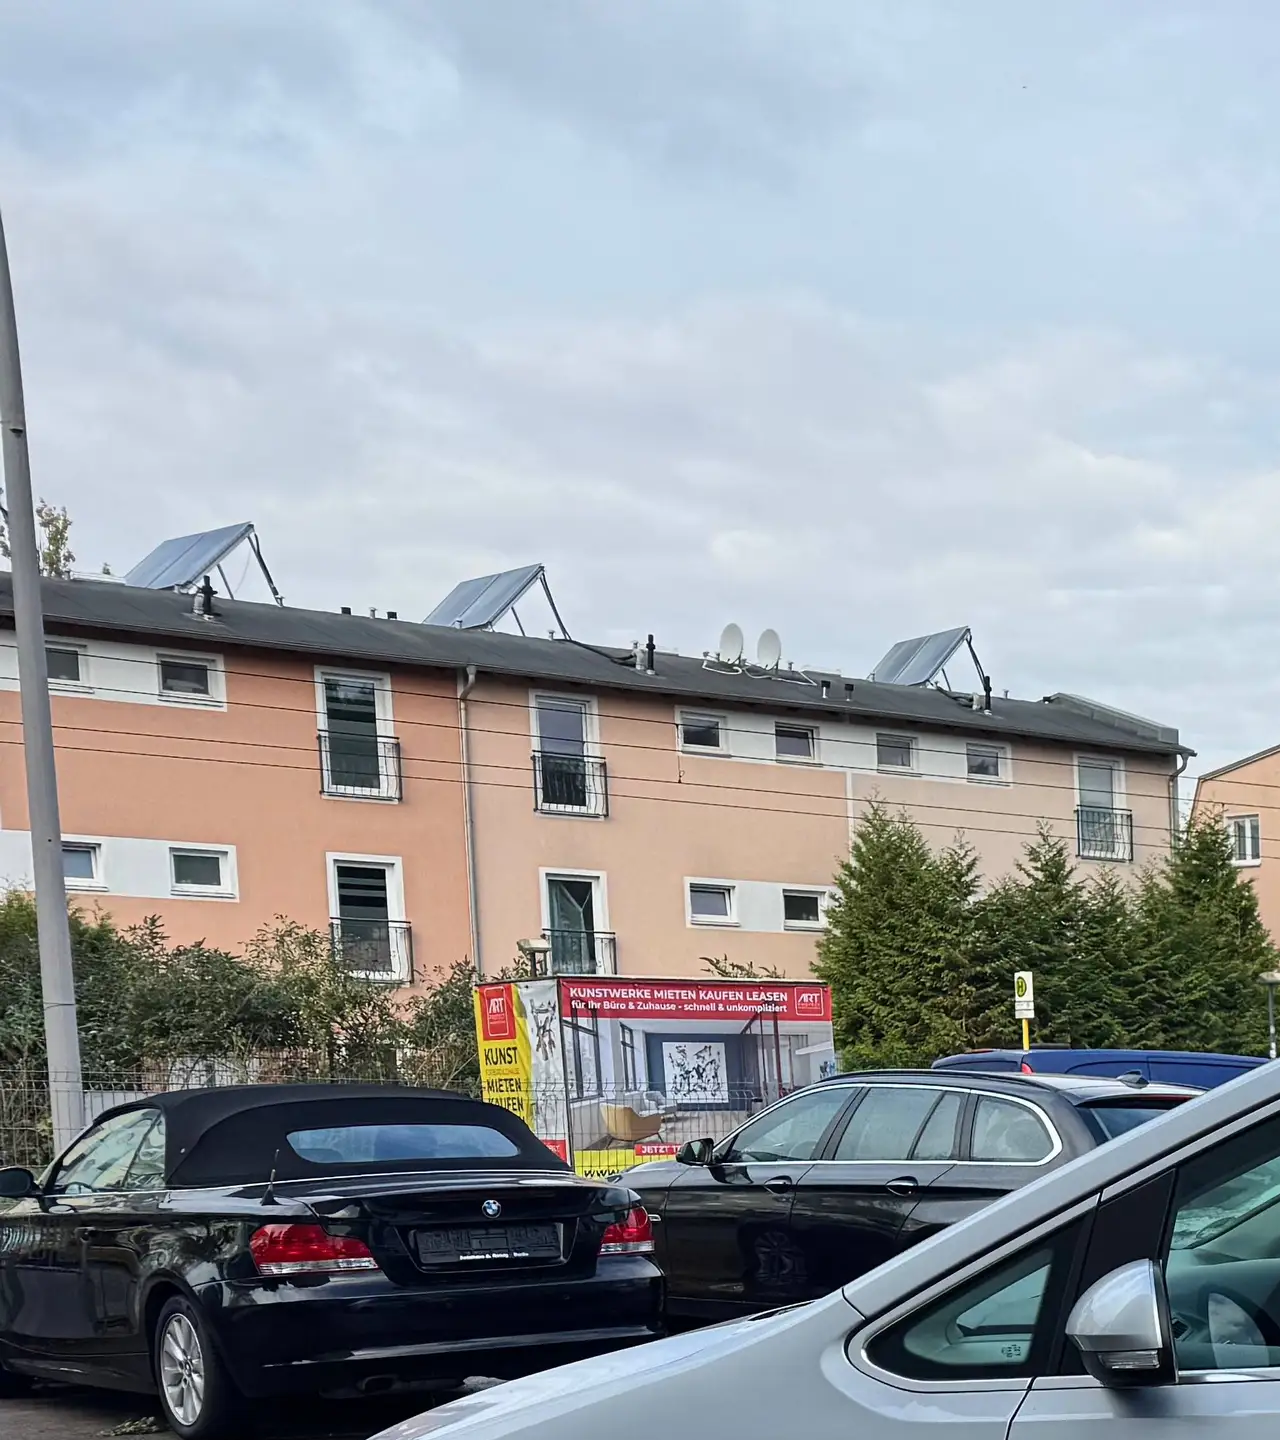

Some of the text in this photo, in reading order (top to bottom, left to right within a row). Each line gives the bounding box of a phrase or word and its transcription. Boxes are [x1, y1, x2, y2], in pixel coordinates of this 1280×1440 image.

[569, 987, 788, 1002] KUNSTWERKE MIETEN KAUFEN LEASEN
[571, 1000, 586, 1009] für
[588, 1000, 601, 1010] Ihr
[603, 1000, 627, 1010] Büro
[628, 1001, 635, 1010] &
[637, 1001, 676, 1011] Zuhause
[683, 1002, 716, 1011] schnell
[718, 1003, 725, 1011] &
[726, 1003, 788, 1014] unkompliziert
[484, 1046, 518, 1066] KUNST
[486, 1077, 522, 1093] MIETEN
[642, 1145, 670, 1154] JETZT
